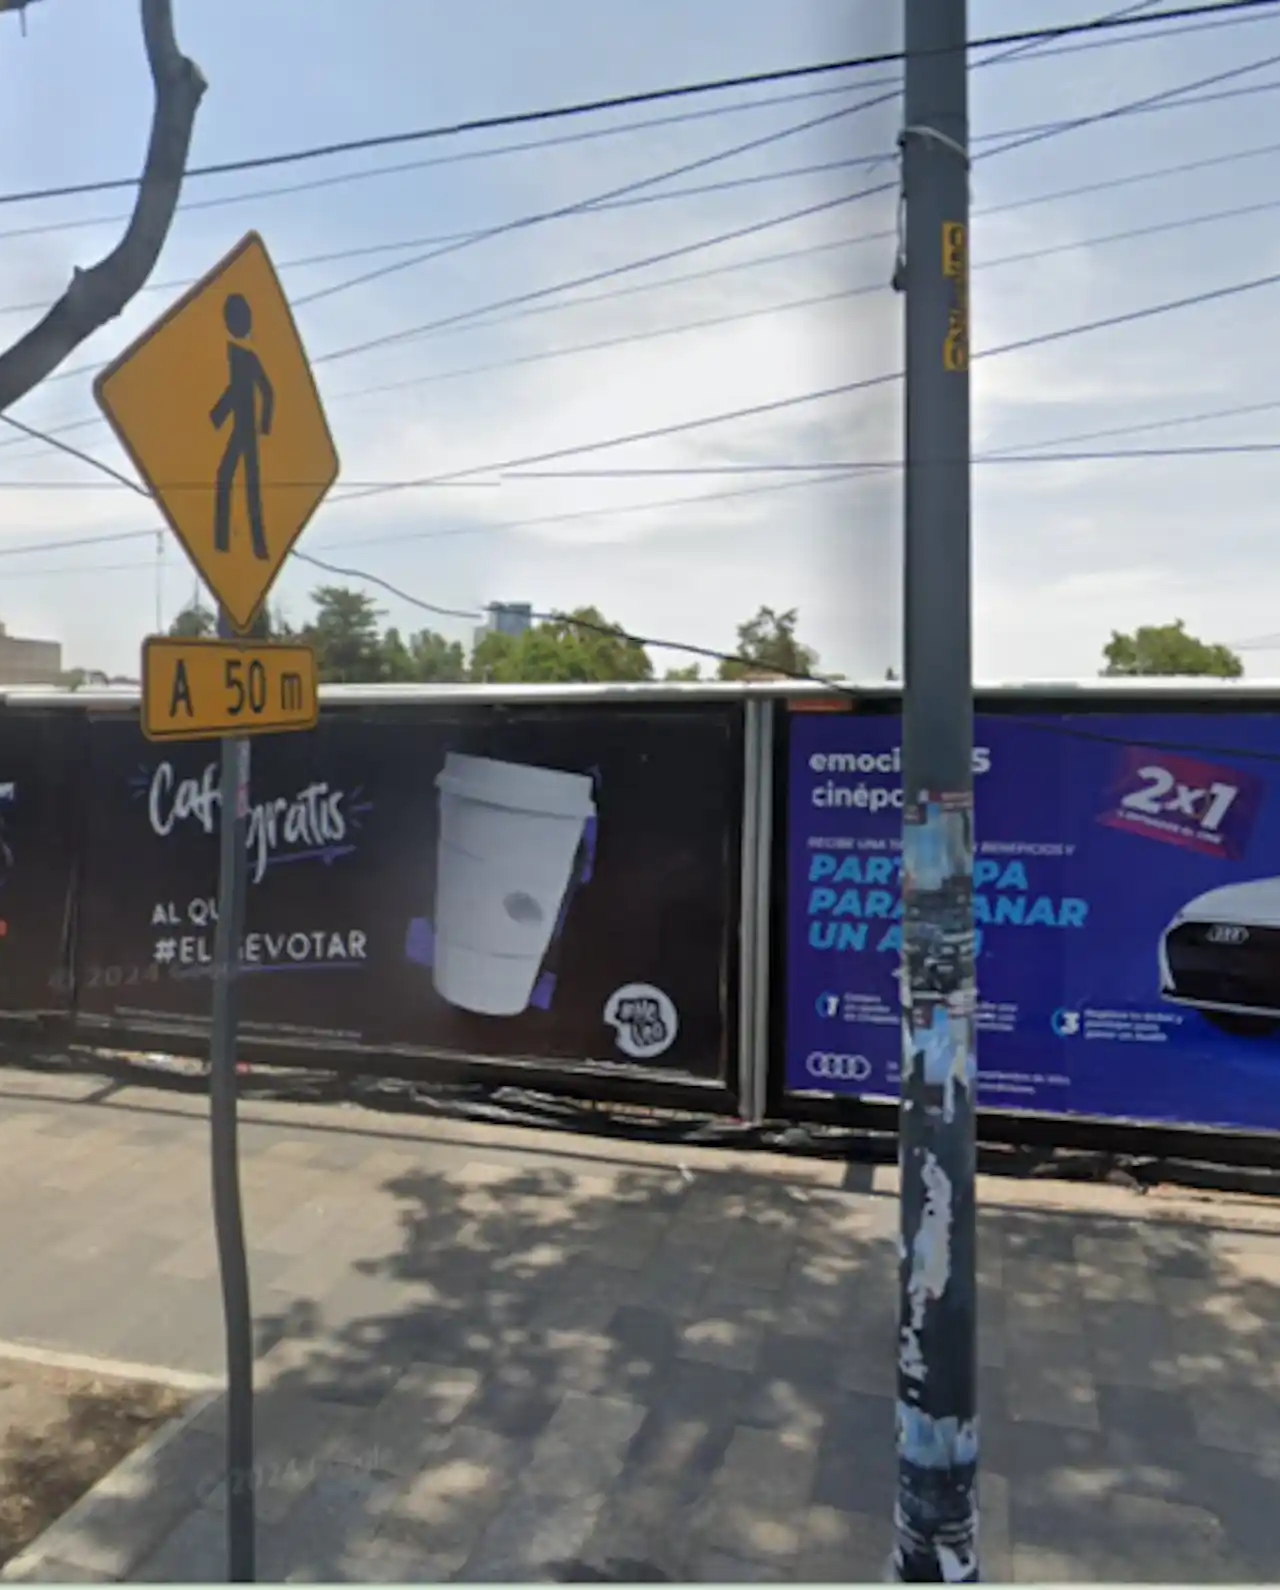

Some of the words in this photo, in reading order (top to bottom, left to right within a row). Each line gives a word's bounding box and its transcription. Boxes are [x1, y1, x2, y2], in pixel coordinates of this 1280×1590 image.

[168, 659, 194, 718] A
[224, 658, 266, 717] 50
[280, 668, 304, 712] m
[148, 761, 224, 837] Caf
[1120, 765, 1239, 832] 2x1
[151, 901, 182, 925] AL
[972, 894, 1090, 928] ANAR
[807, 920, 869, 953] UN
